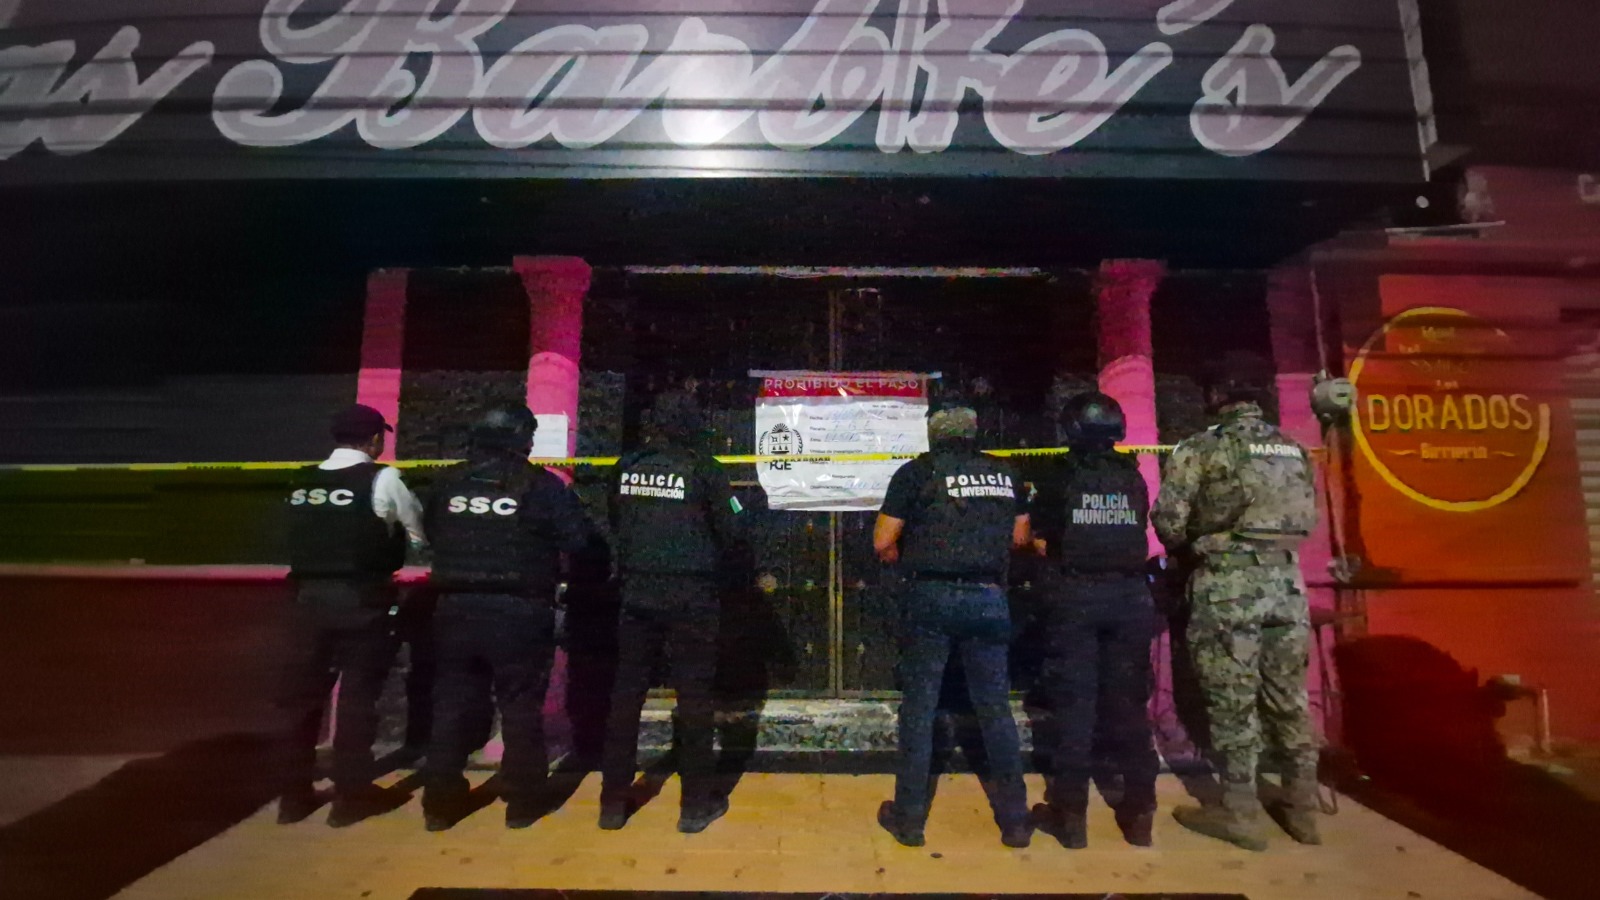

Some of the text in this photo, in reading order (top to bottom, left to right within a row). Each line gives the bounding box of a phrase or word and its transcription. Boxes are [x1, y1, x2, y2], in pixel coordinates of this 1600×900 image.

[763, 378, 919, 390] PROHIBIDO EL PASO
[1367, 394, 1533, 431] DORADOS
[621, 473, 685, 489] POLICÍA
[290, 489, 355, 506] SSC
[620, 485, 685, 500] DE INVESTIGACIÓN
[1082, 491, 1130, 510] POLICÍA
[448, 496, 518, 515] SSC
[1072, 509, 1138, 525] MUNICIPAL
